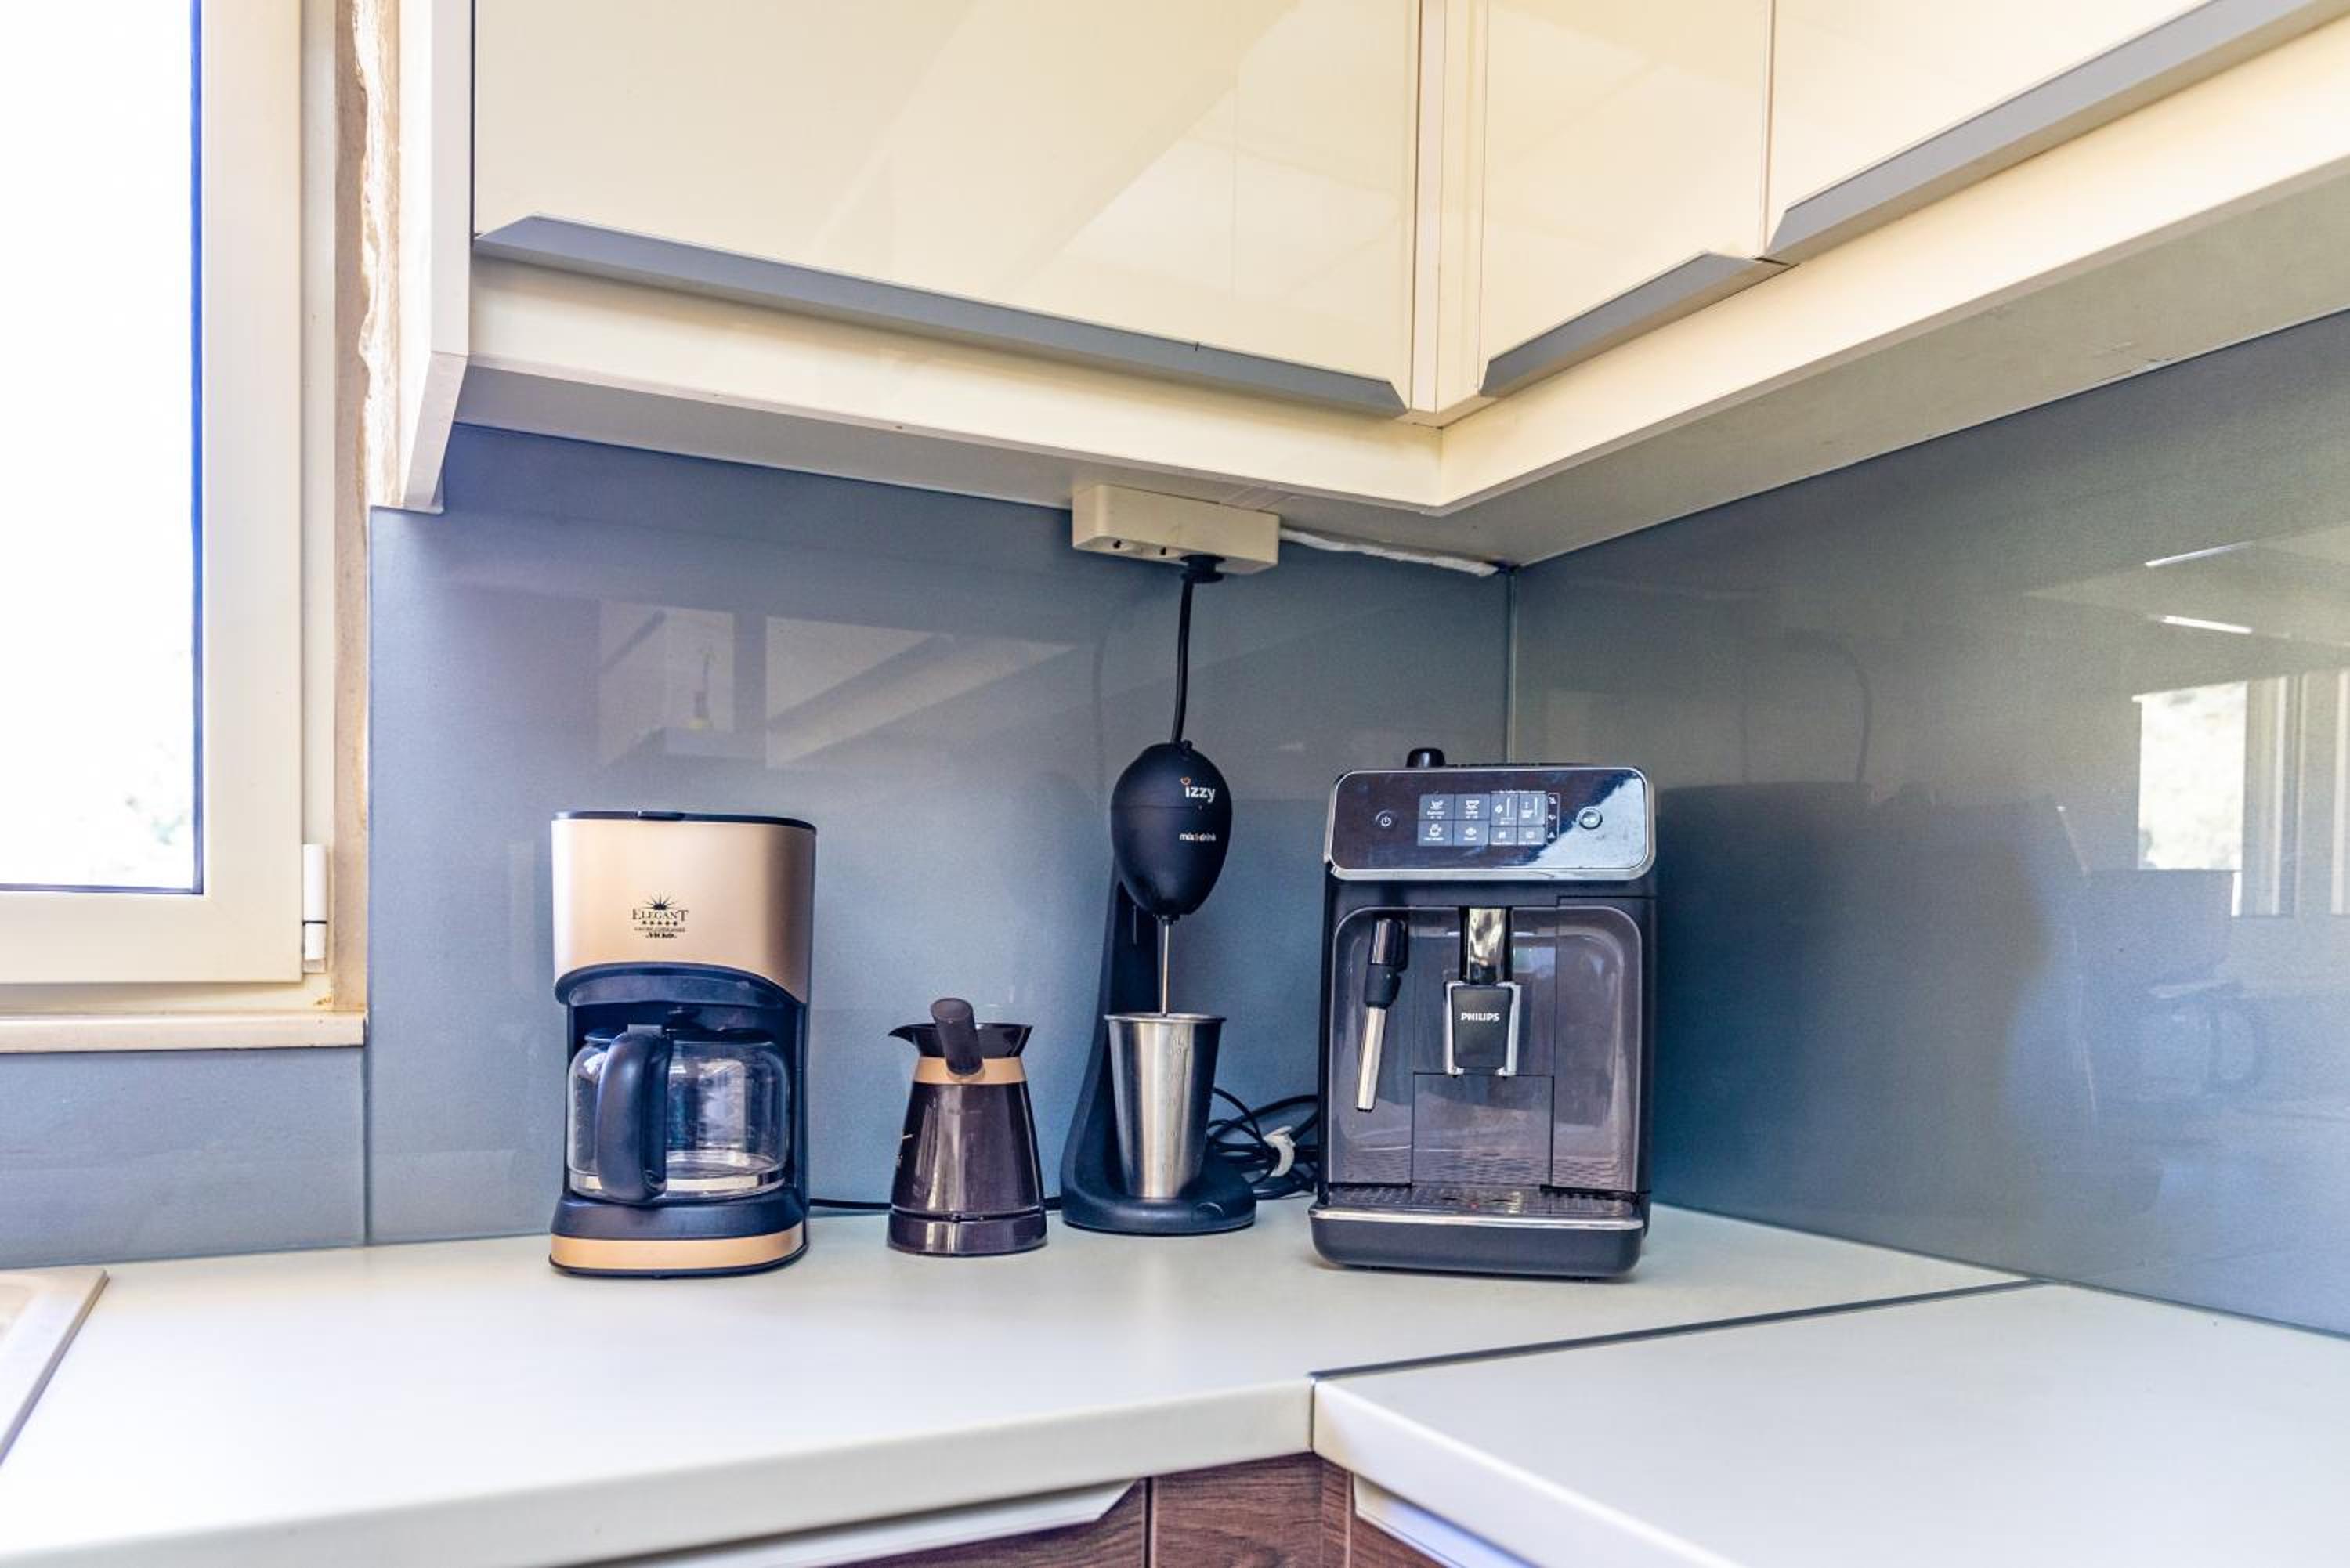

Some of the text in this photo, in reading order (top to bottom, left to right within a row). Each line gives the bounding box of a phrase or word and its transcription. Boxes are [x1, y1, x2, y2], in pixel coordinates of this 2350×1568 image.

[1181, 778, 1216, 803] izzy
[632, 909, 689, 921] ELEGANT
[1461, 1012, 1500, 1021] PHILIPS
